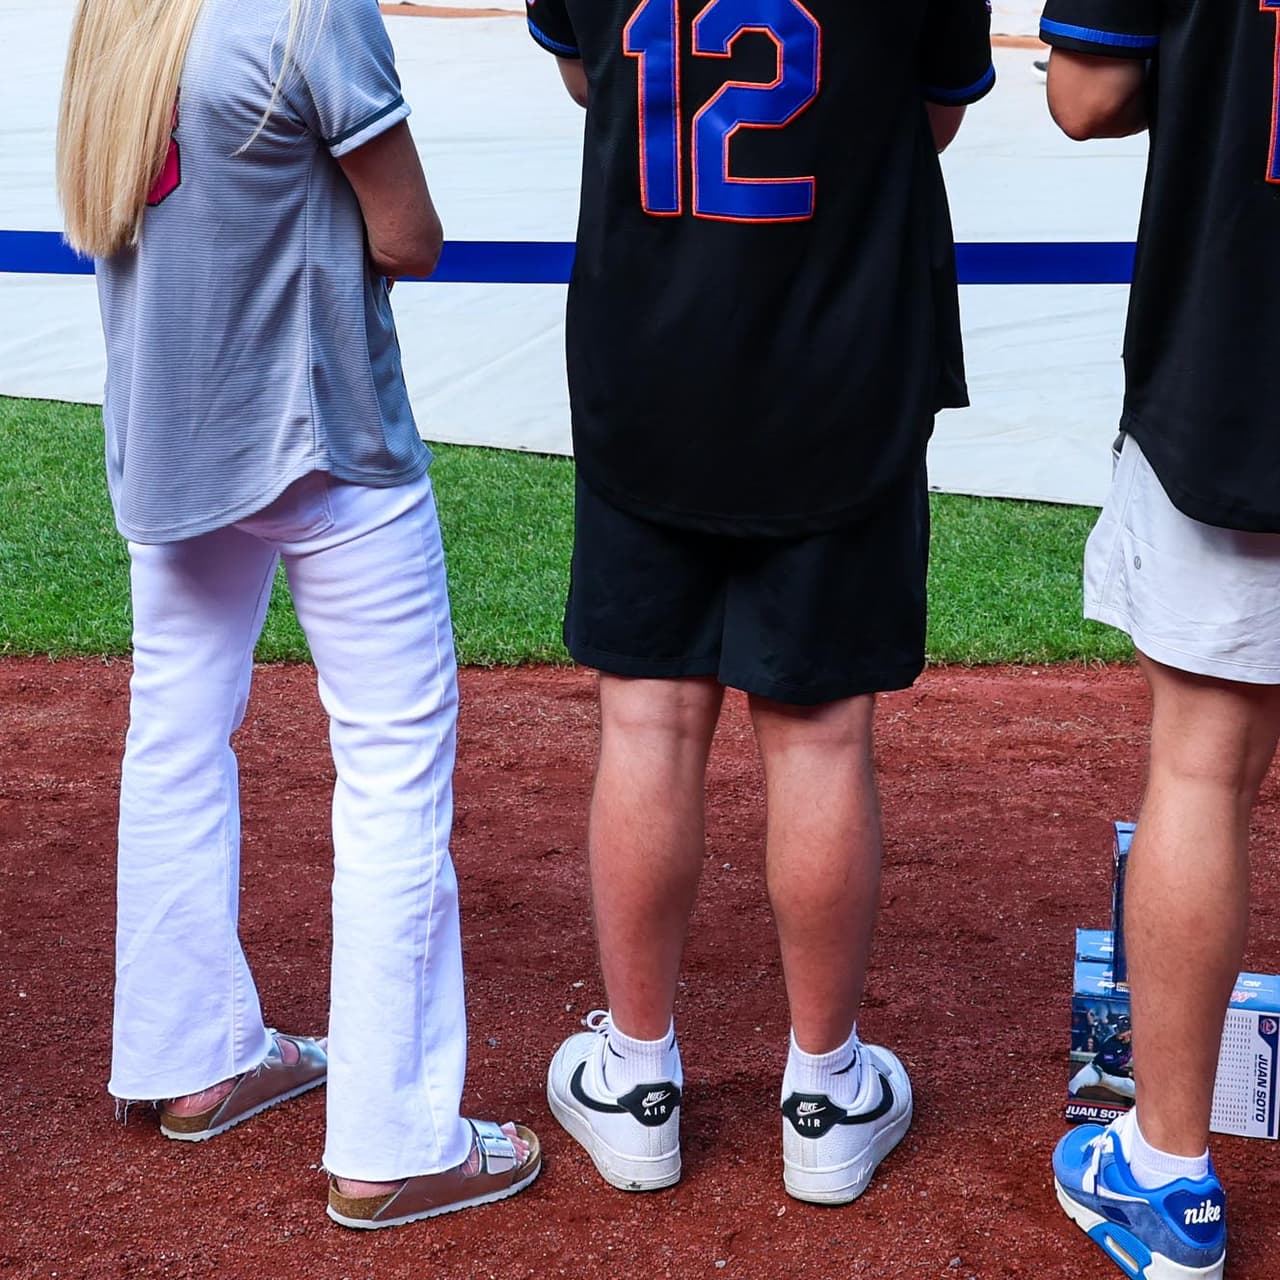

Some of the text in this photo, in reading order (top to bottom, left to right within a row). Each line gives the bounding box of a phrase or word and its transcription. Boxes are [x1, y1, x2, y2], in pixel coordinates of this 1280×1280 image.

[1256, 1054, 1269, 1093] JUAN
[644, 1106, 666, 1116] AIR
[1066, 1105, 1097, 1118] JUAN
[1255, 1094, 1268, 1123] SOTO
[798, 1118, 821, 1128] AIR
[1184, 1200, 1221, 1224] nike
